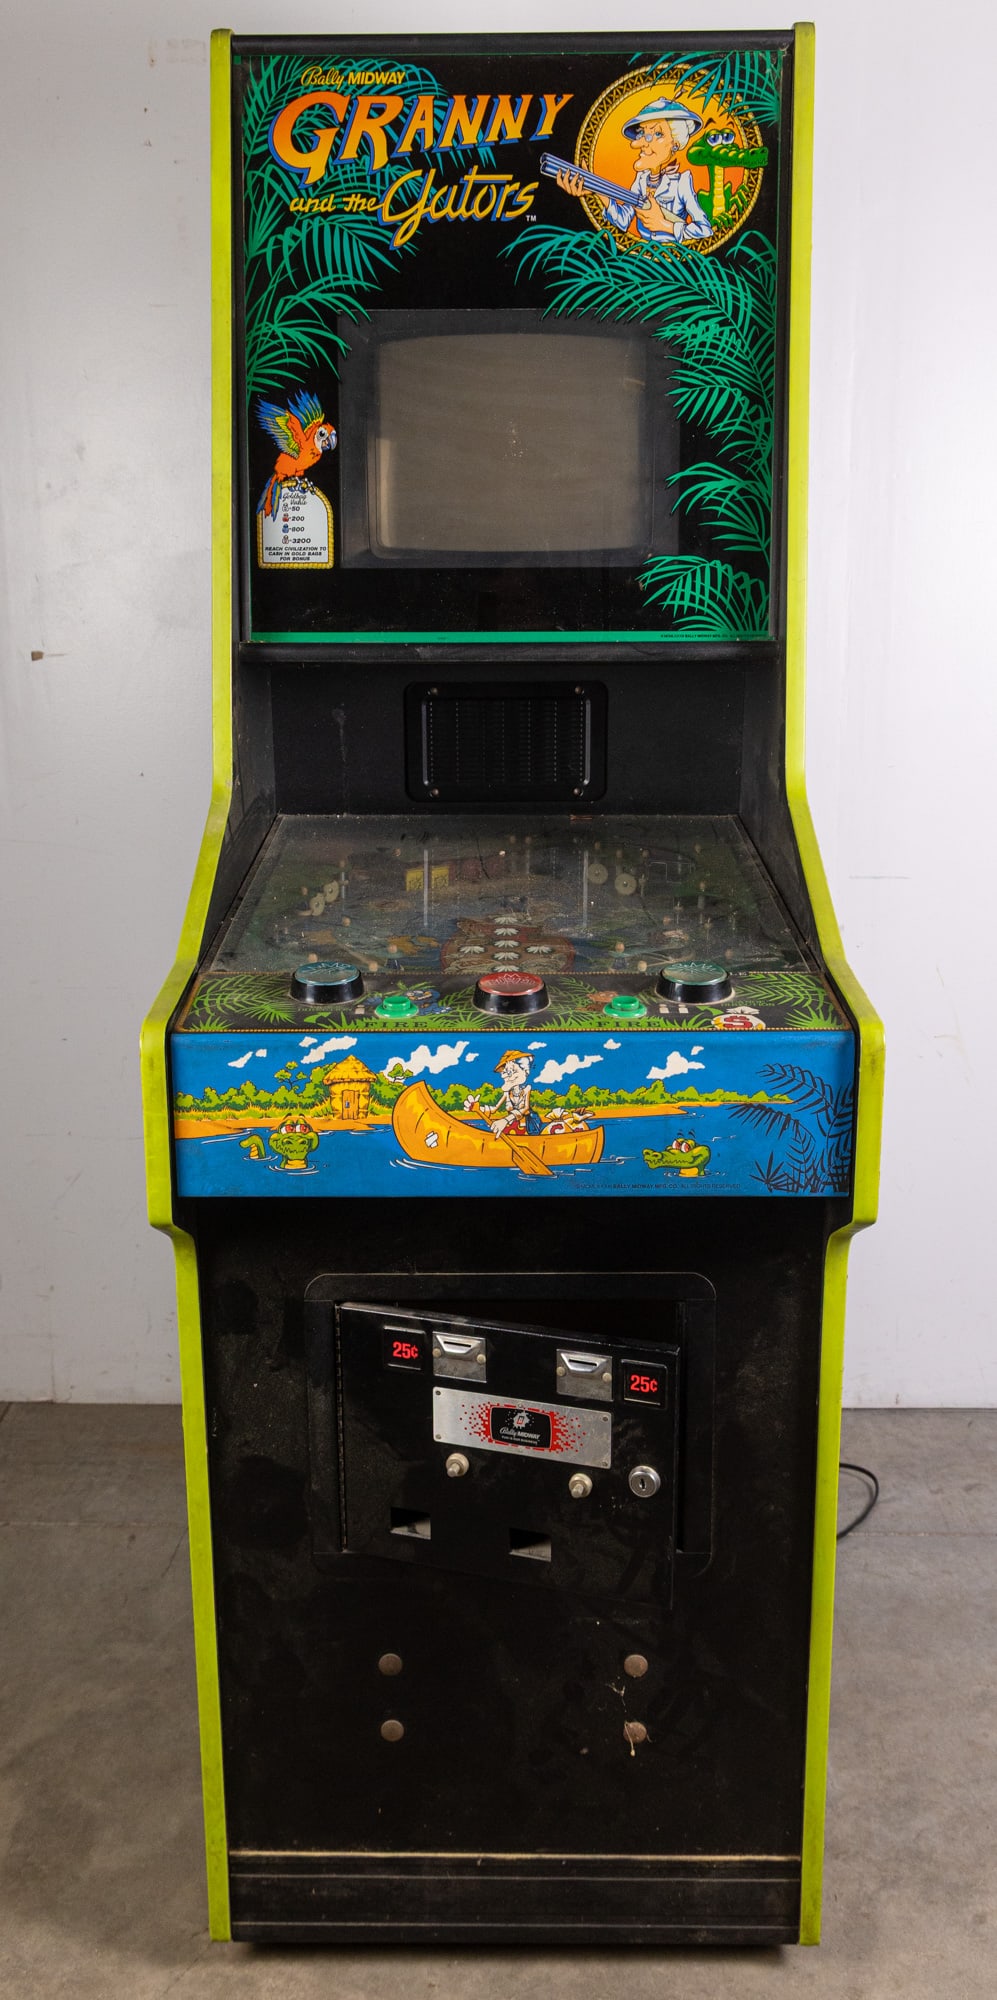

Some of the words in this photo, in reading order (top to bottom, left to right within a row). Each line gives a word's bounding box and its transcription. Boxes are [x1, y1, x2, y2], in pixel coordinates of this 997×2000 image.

[301, 66, 344, 90] Bally
[347, 71, 406, 85] MIDWAY
[269, 91, 574, 188] GRANNY
[289, 194, 336, 212] and
[342, 193, 384, 212] the
[378, 165, 539, 250] Gators
[393, 1341, 418, 1359] 25¢
[630, 1374, 657, 1392] 25¢
[517, 1431, 541, 1439] MIDWAY
